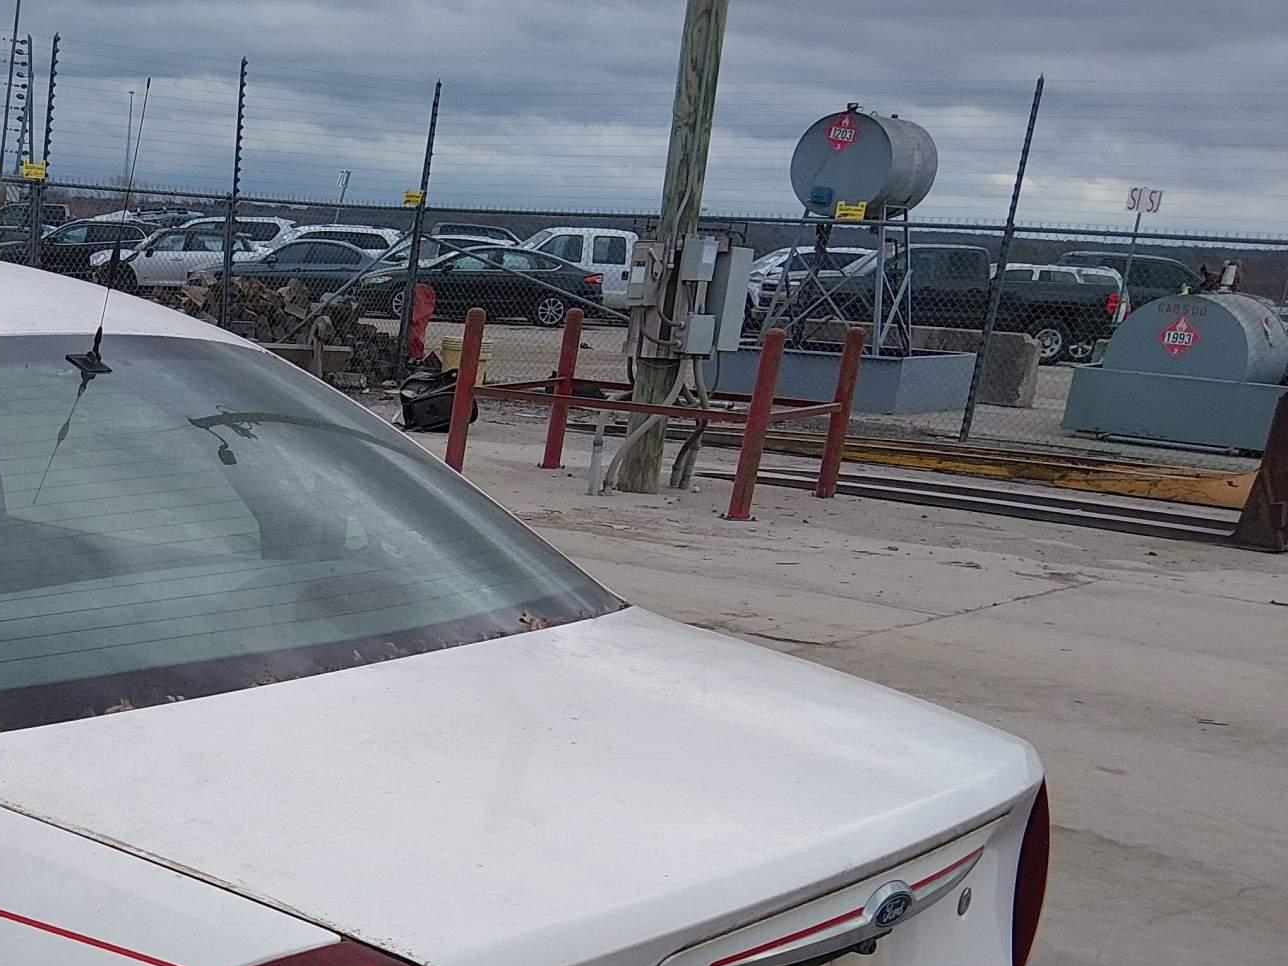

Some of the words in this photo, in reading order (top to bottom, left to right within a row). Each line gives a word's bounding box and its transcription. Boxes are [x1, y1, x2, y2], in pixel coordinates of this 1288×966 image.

[833, 128, 852, 141] 1203
[1166, 332, 1192, 344] 1993
[882, 899, 905, 922] Ford
